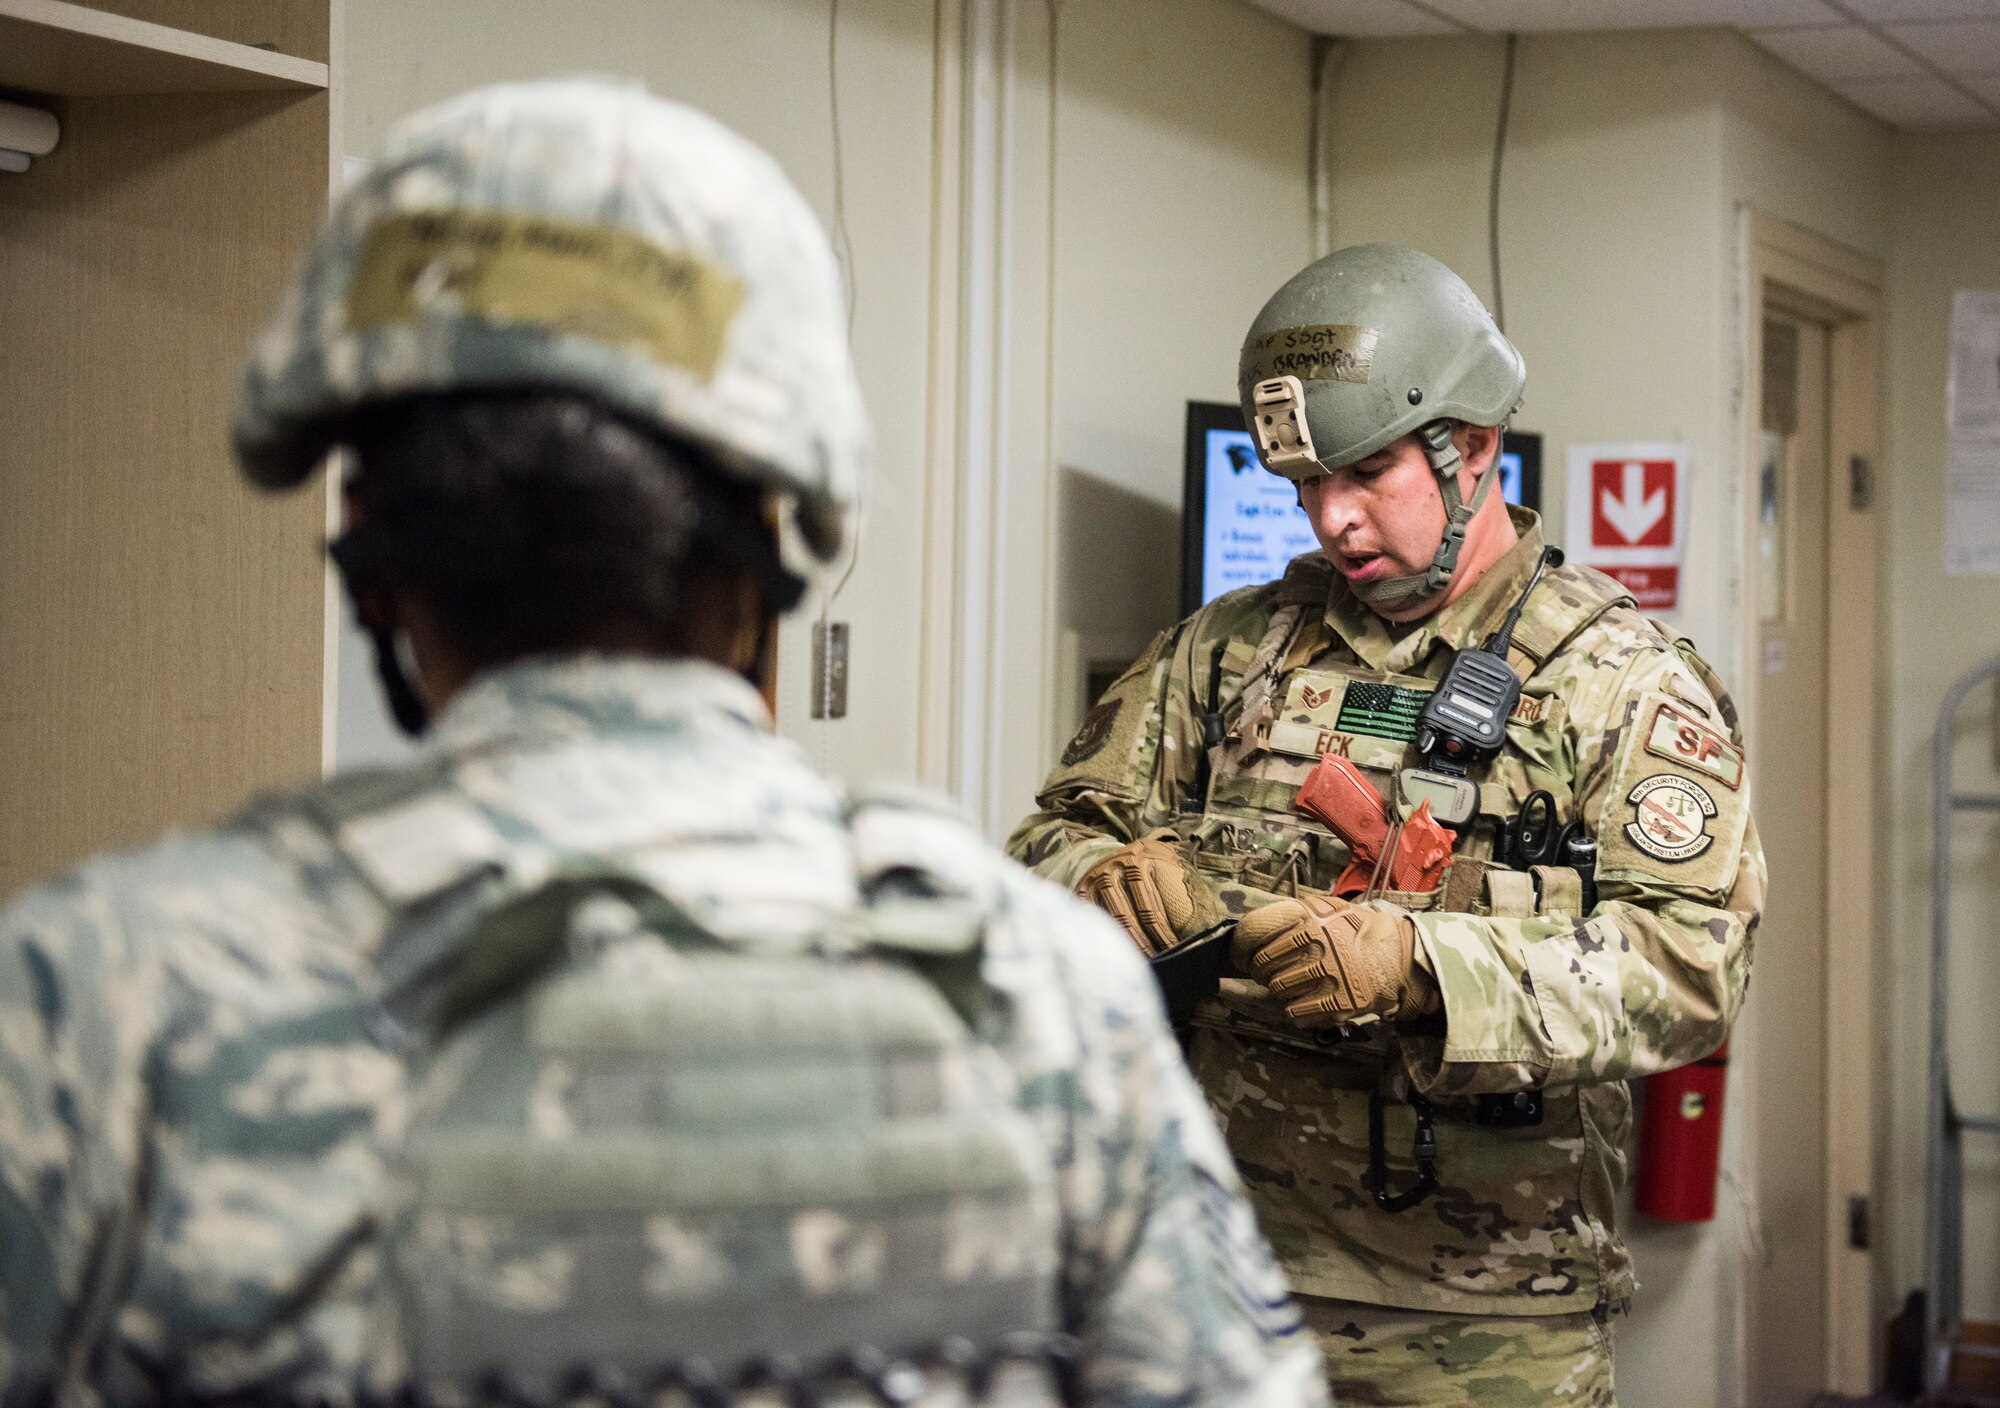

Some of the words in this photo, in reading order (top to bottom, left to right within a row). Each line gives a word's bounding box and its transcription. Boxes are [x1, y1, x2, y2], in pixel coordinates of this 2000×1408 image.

[1315, 730, 1354, 758] ECK
[1675, 725, 1722, 762] SF
[1642, 777, 1679, 790] SECURITY
[1680, 780, 1707, 802] FORCES
